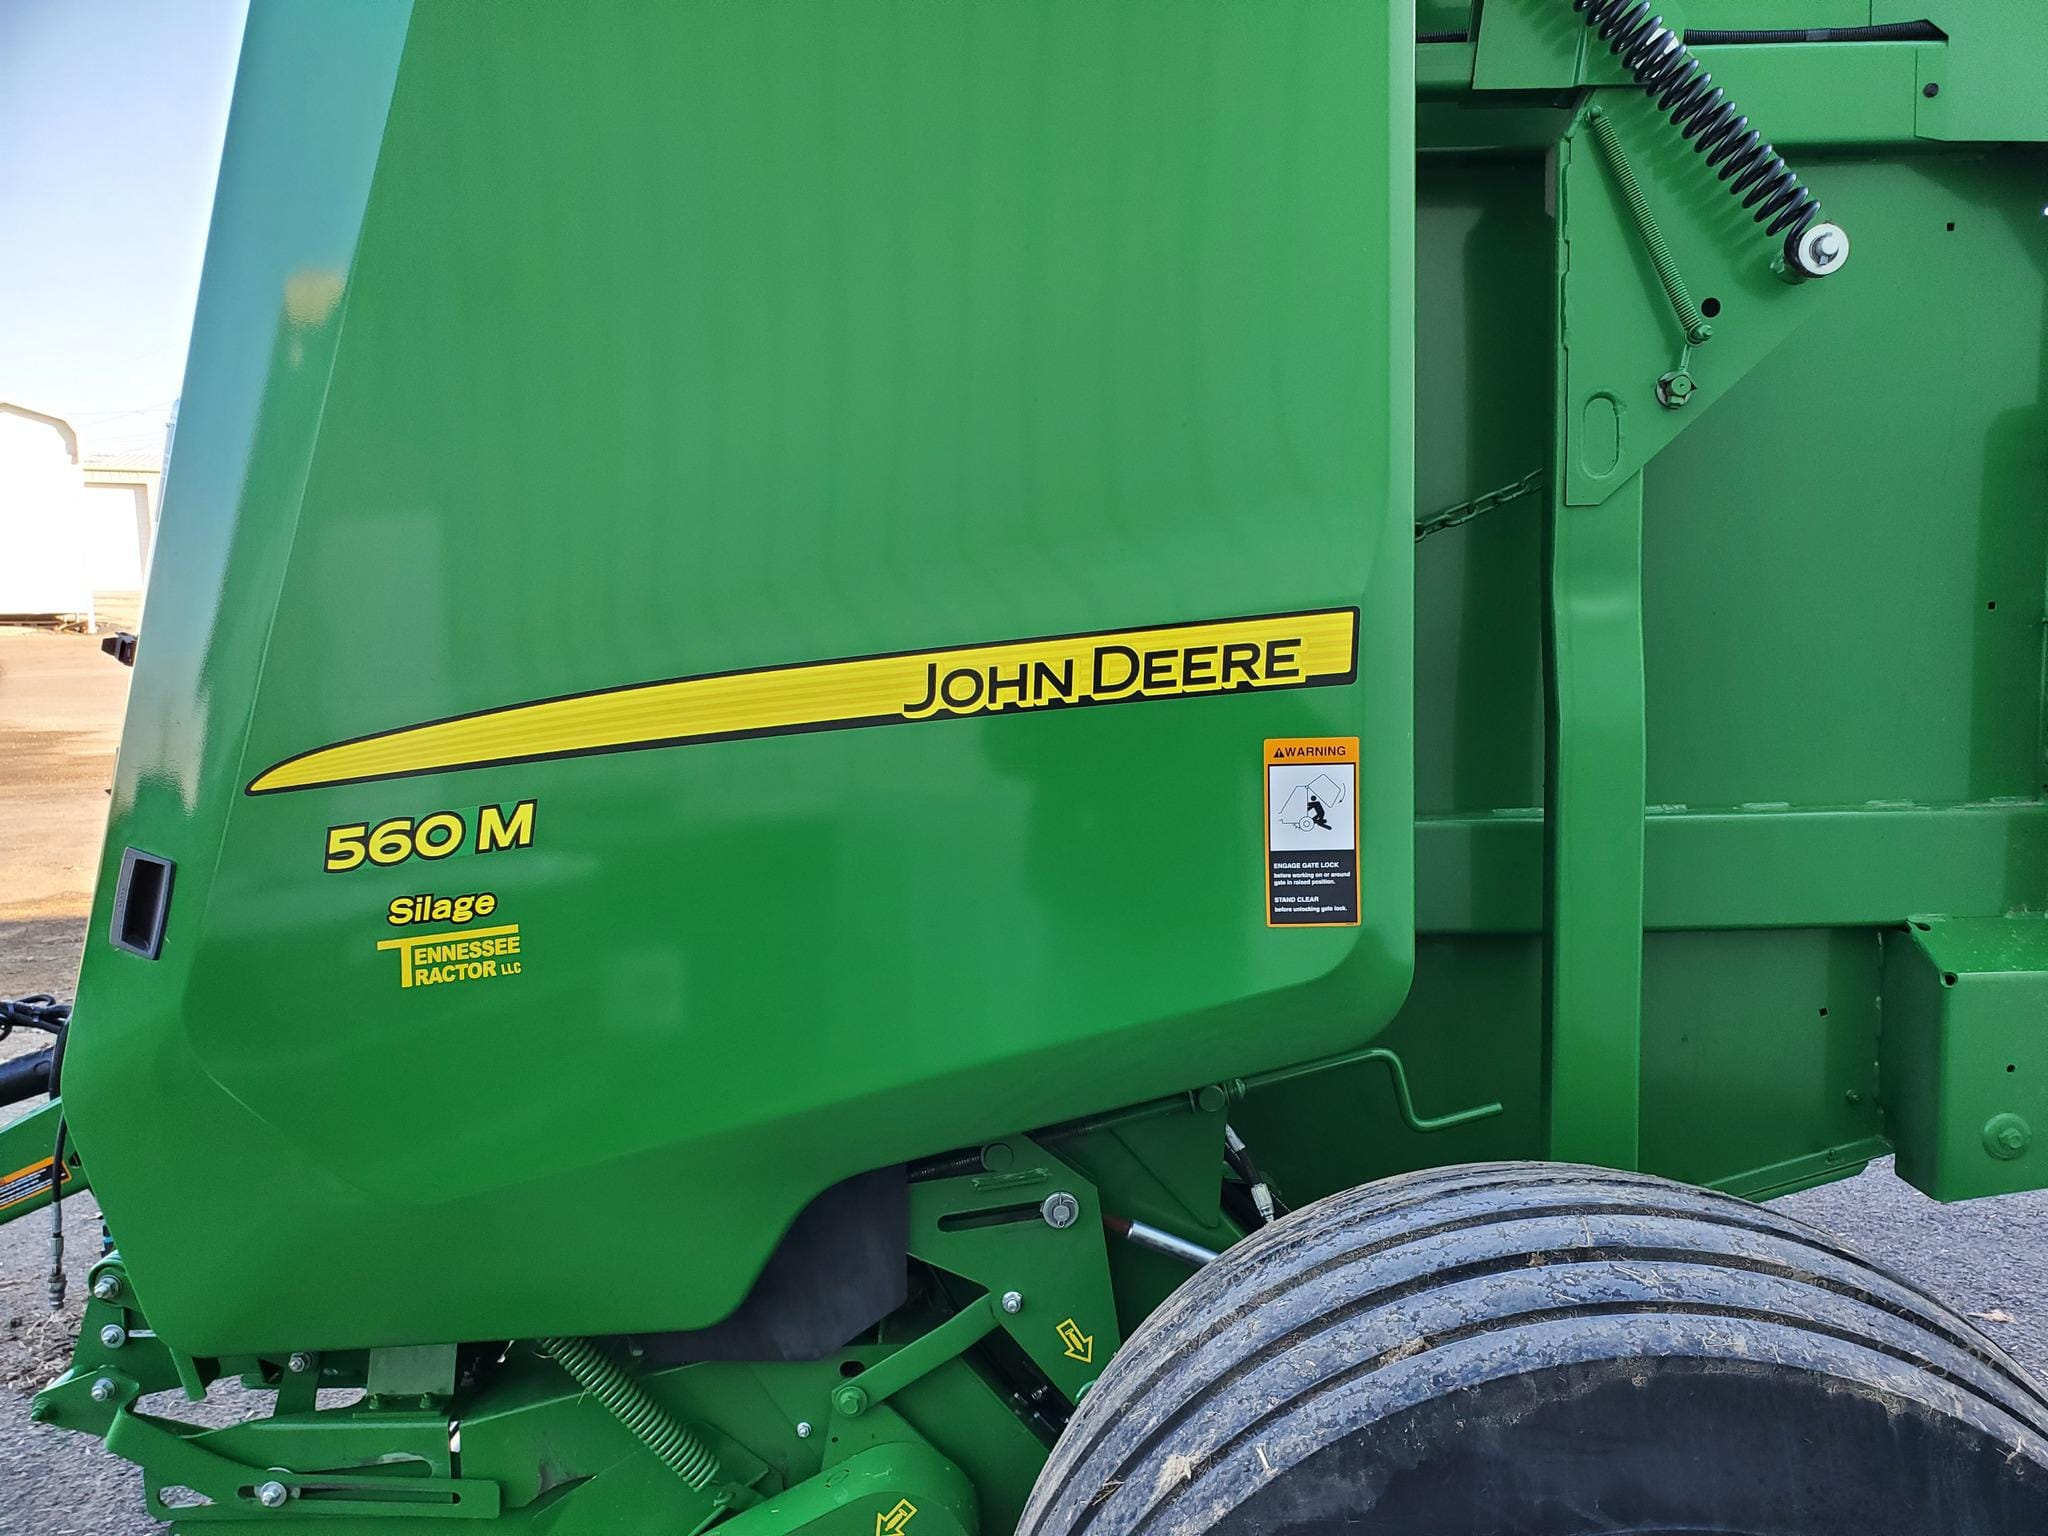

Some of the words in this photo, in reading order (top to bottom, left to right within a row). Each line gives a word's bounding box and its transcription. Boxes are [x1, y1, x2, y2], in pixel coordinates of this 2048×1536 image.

[902, 658, 1076, 716] JOHN
[1092, 638, 1305, 695] DEERE
[1285, 745, 1347, 758] WARNING
[325, 811, 465, 873] 560
[475, 799, 537, 854] M
[387, 891, 498, 926] Silage
[501, 960, 522, 975] LLC
